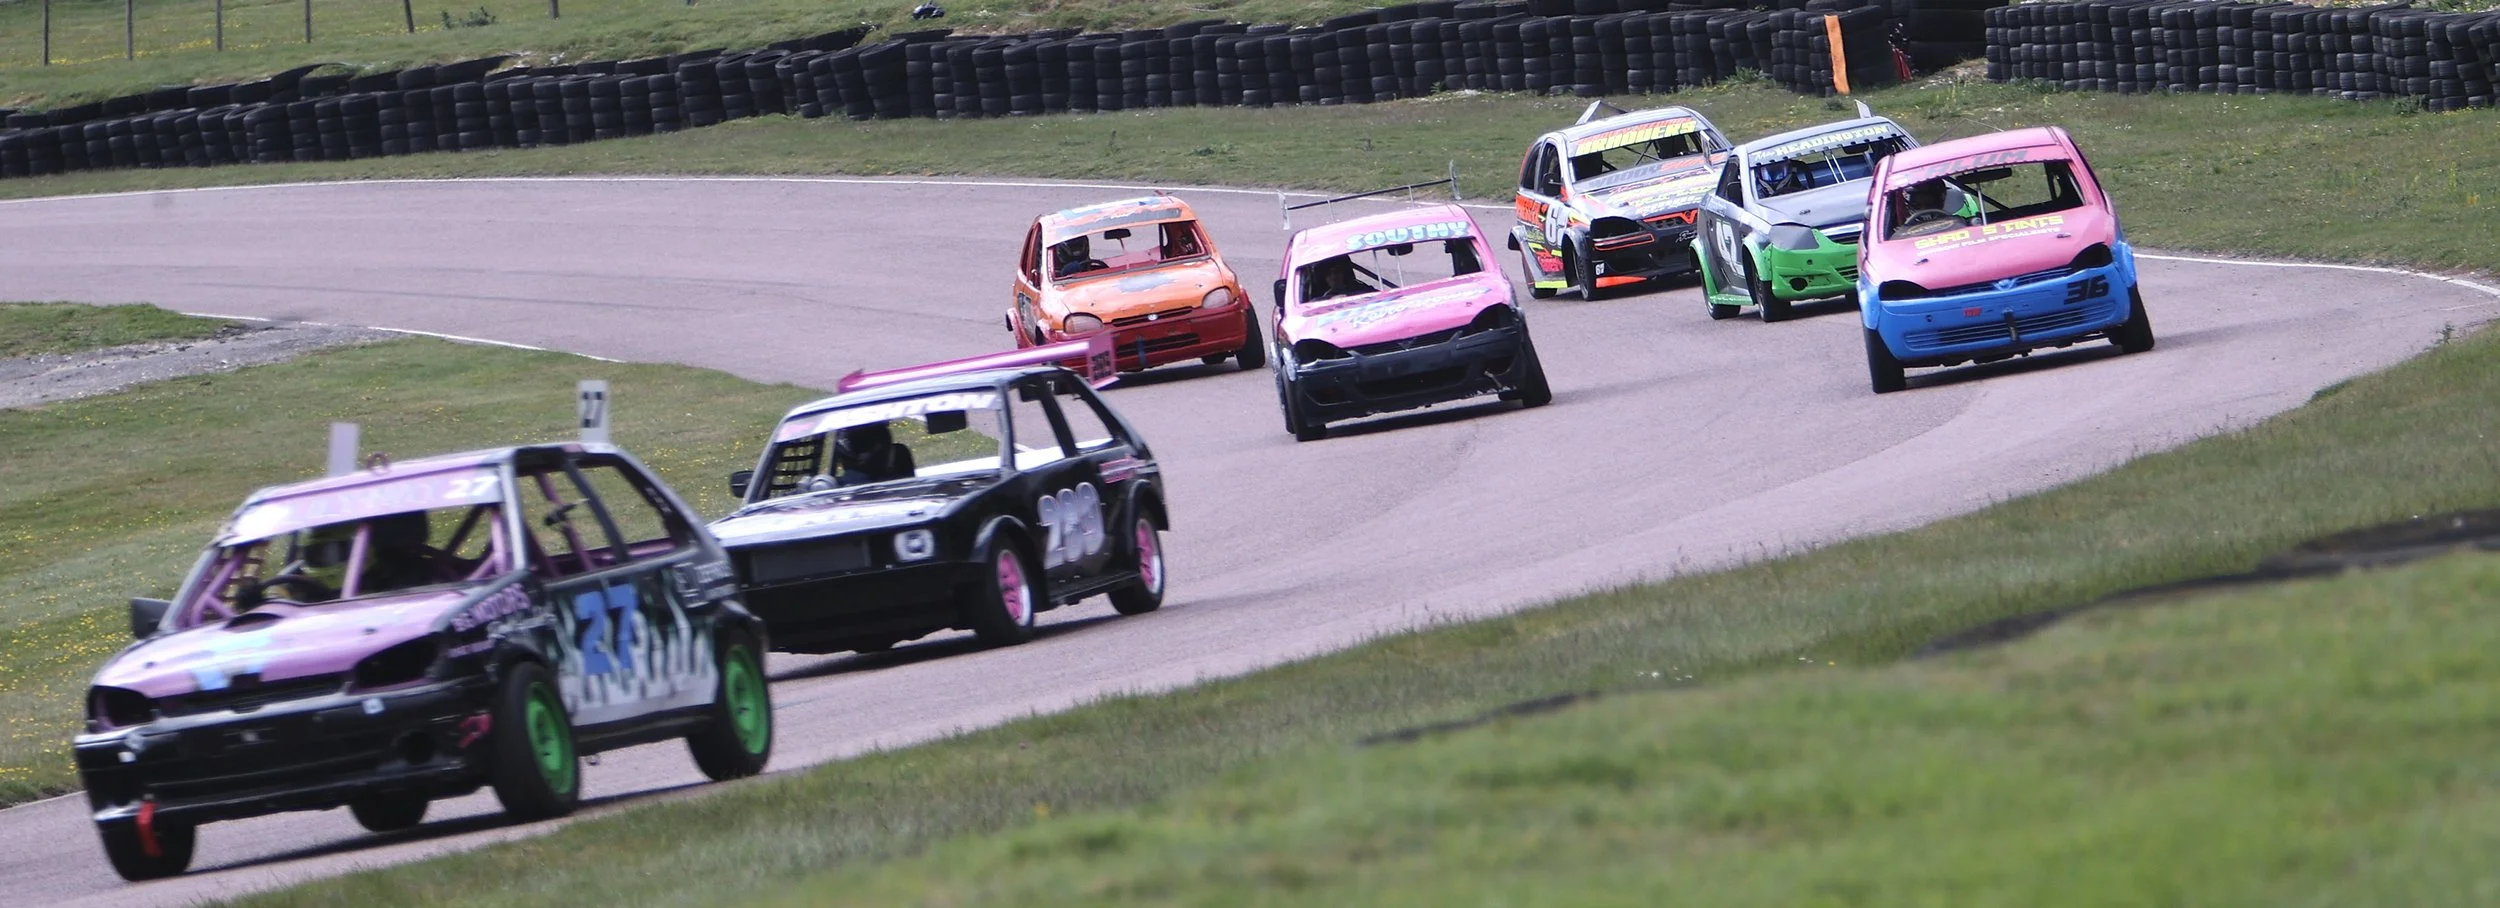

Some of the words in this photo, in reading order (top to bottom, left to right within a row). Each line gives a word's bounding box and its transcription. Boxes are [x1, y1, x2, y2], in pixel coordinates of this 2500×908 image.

[1777, 126, 1889, 156] HEADINGTON
[2002, 215, 2064, 232] TINTS
[2063, 274, 2109, 305] 36
[581, 391, 604, 428] 27
[445, 476, 498, 499] 27
[576, 583, 637, 674] 27
